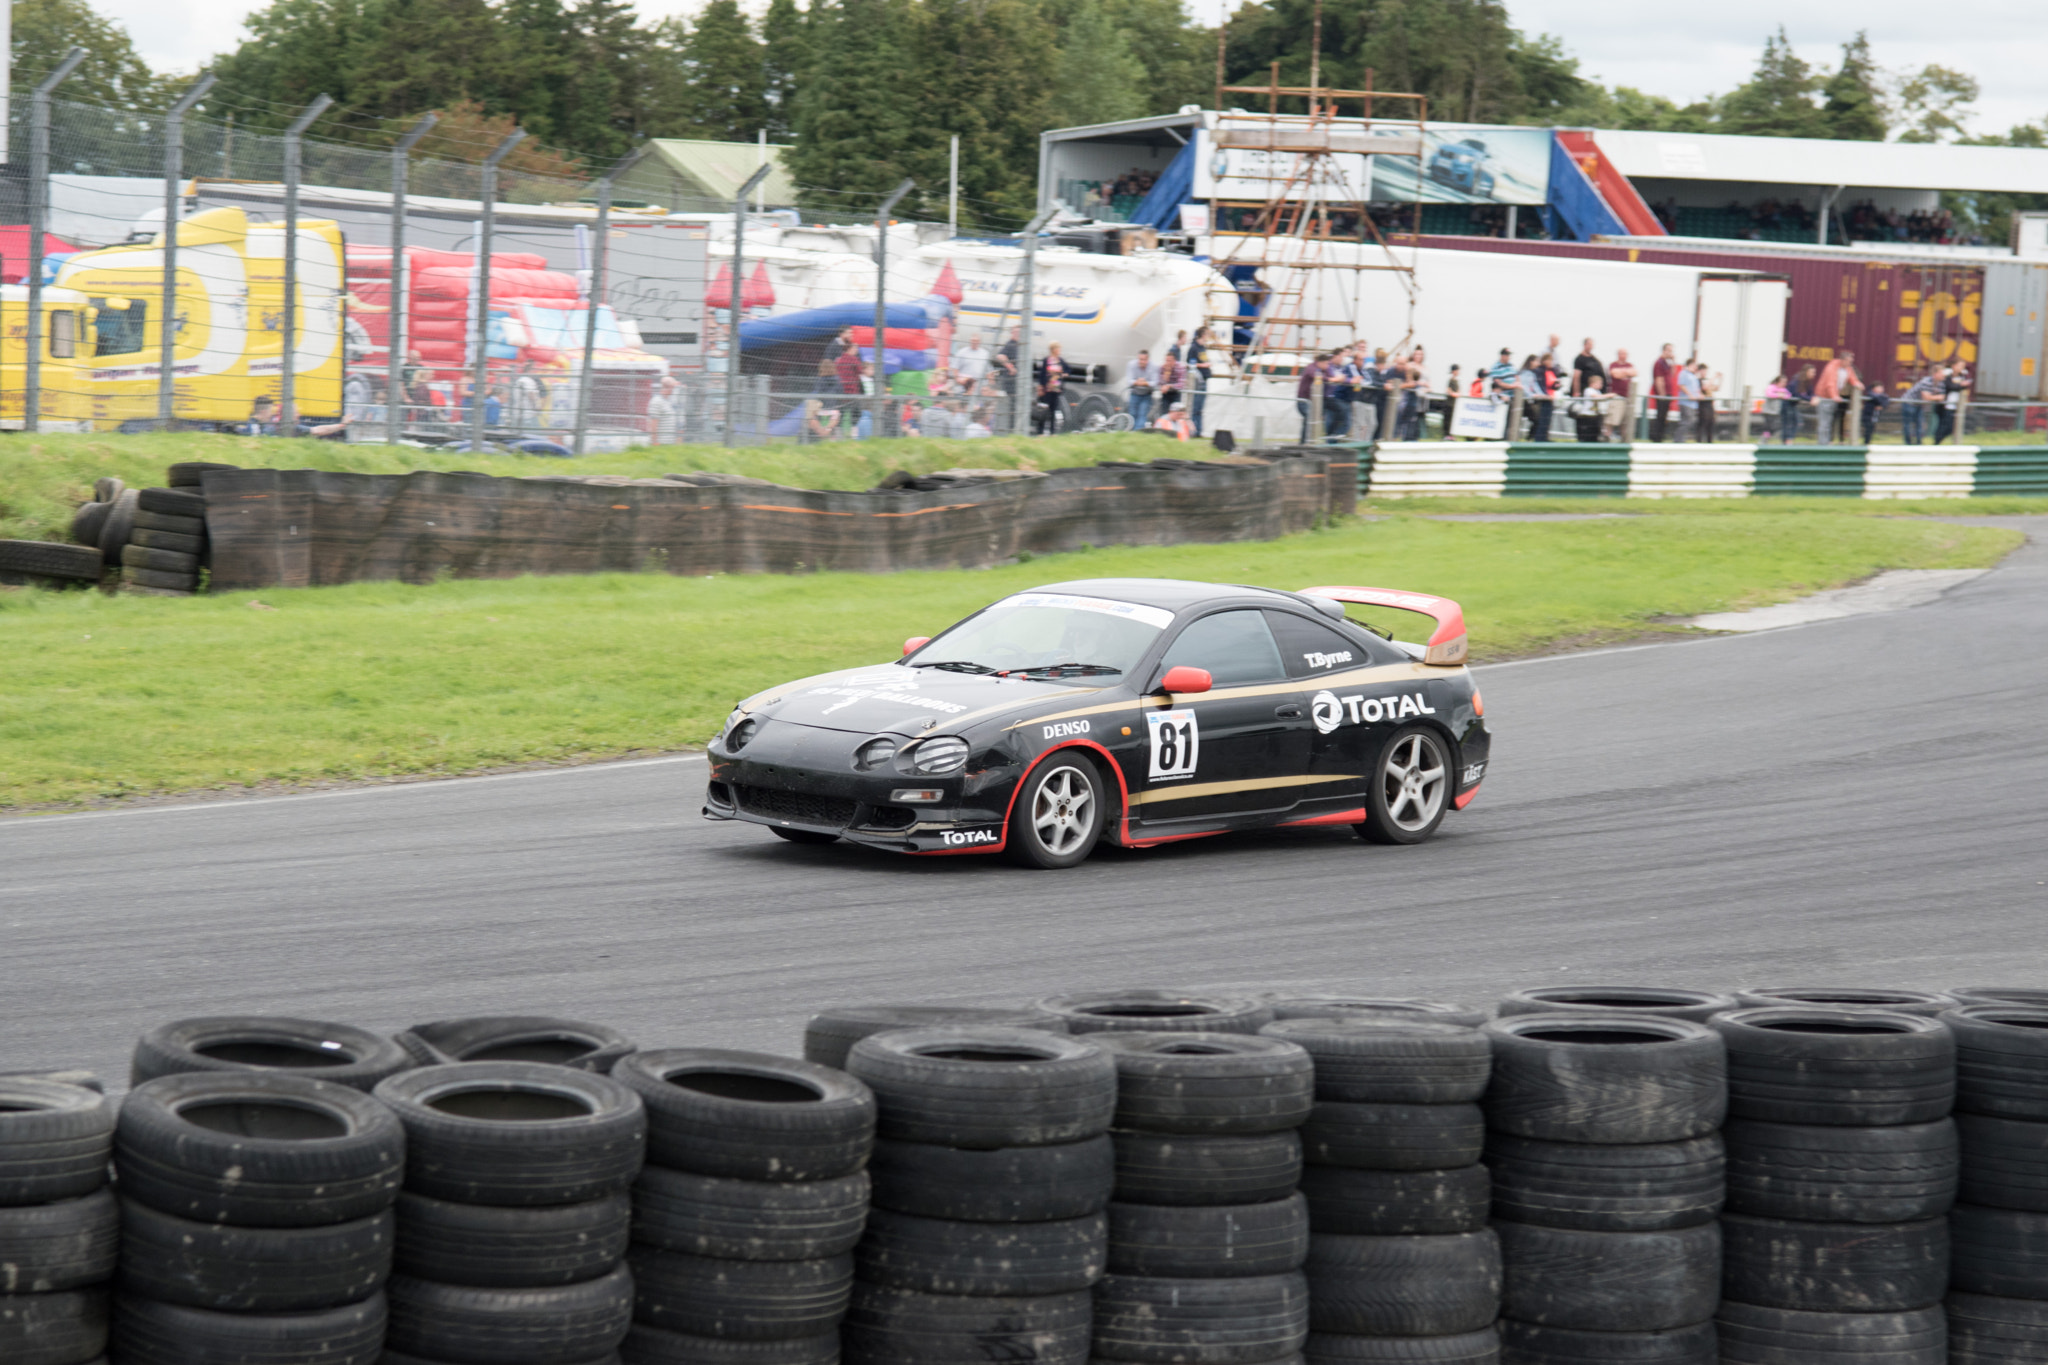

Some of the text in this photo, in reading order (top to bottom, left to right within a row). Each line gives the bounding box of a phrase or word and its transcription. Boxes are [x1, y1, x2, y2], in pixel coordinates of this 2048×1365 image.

[1303, 650, 1353, 669] T.Byrne
[1341, 692, 1436, 725] TOTAL
[1043, 719, 1091, 740] DENSO
[1158, 721, 1193, 771] 81
[939, 829, 998, 845] TOTAL
